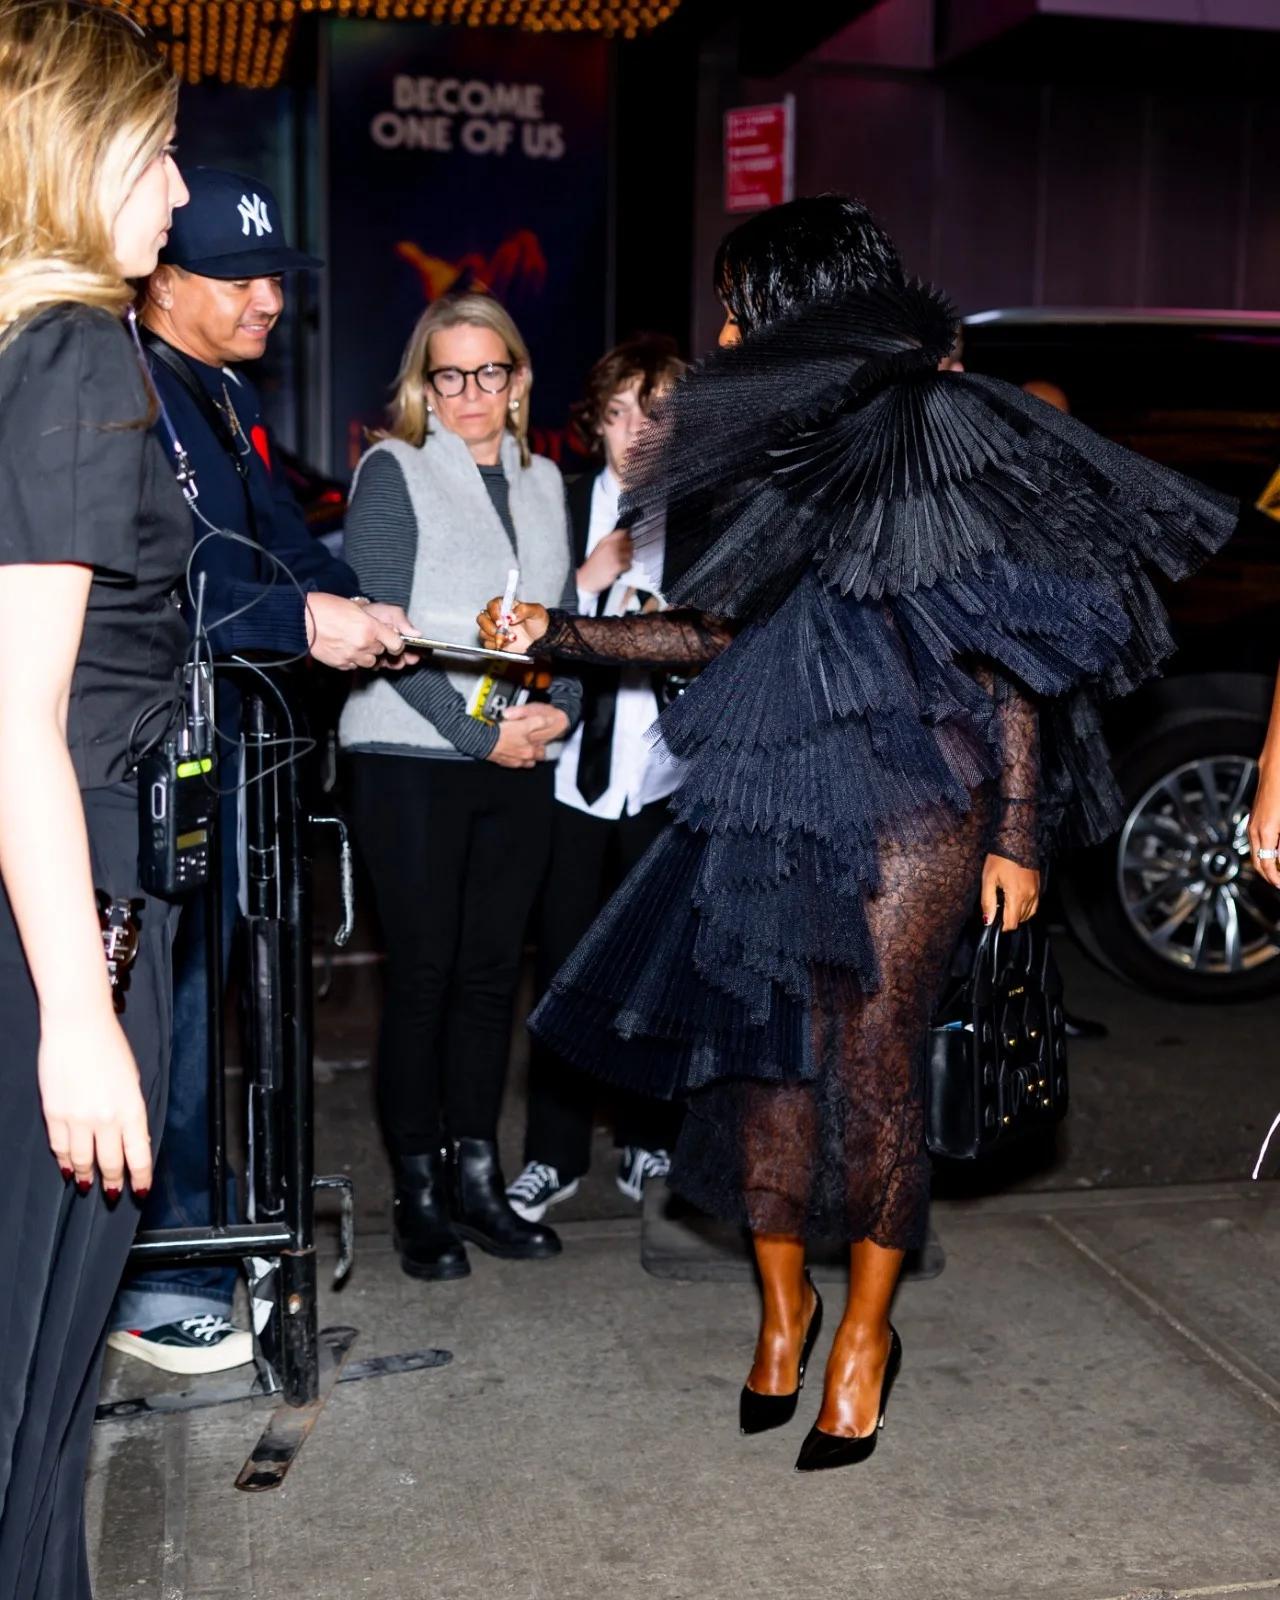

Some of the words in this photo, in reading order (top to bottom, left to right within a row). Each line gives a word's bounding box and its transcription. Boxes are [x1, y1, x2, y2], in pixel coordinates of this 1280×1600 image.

[394, 75, 543, 118] BECOME
[370, 112, 452, 152] ONE
[460, 119, 514, 156] OF
[522, 122, 565, 159] US
[237, 193, 272, 236] NY
